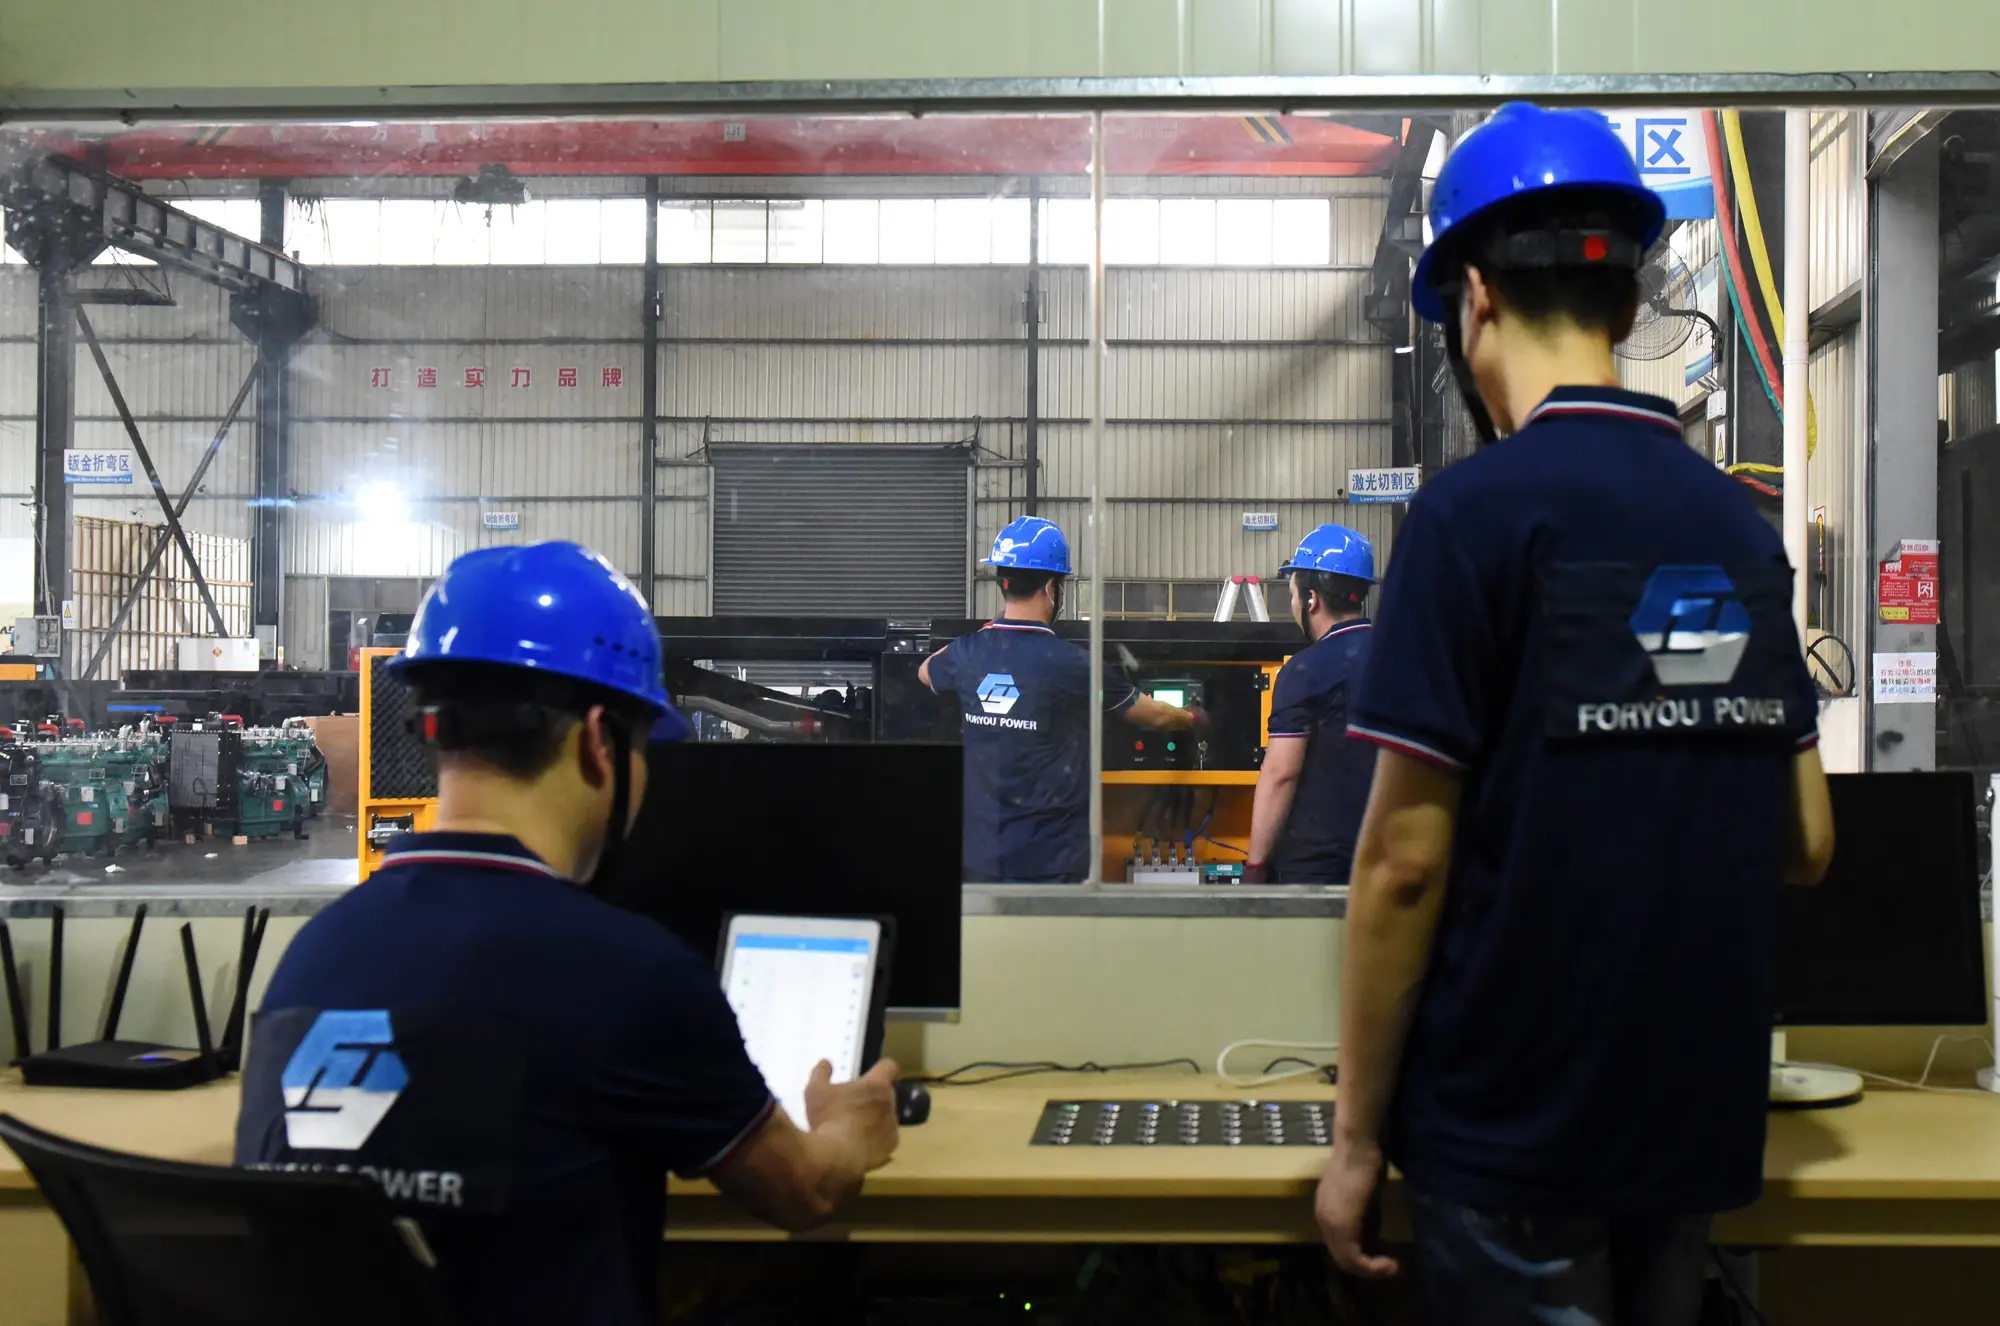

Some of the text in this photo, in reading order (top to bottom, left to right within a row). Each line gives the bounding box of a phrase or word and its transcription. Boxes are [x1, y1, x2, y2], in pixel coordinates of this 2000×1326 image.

[371, 367, 622, 388] 打造实力品牌
[68, 454, 129, 471] 钣金折弯区
[1352, 472, 1415, 491] 激光切割区
[1000, 718, 1036, 730] POWER
[1577, 698, 1700, 733] FORYOU
